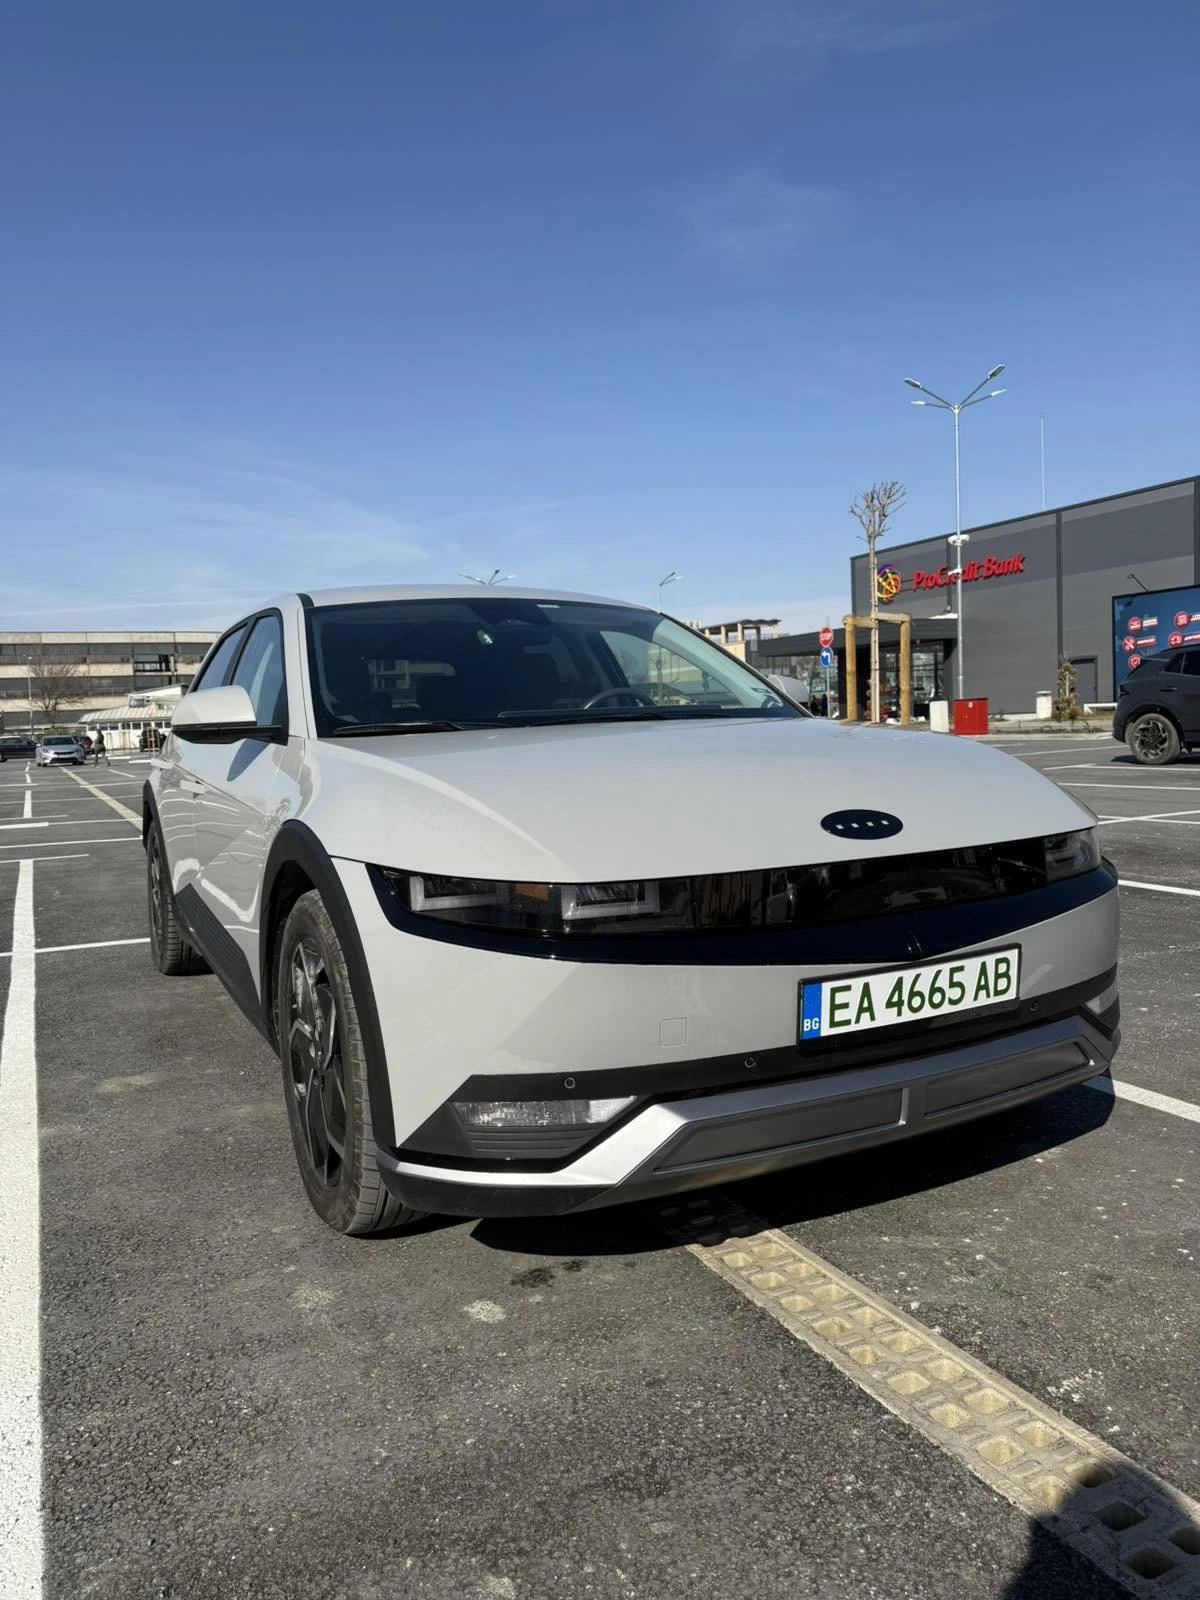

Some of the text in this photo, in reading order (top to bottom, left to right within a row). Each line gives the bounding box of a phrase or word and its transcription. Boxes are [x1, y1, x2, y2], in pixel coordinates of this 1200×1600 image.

[983, 552, 1025, 578] Bank
[829, 957, 1012, 1029] EA 4665 AB
[804, 1017, 819, 1031] BG
